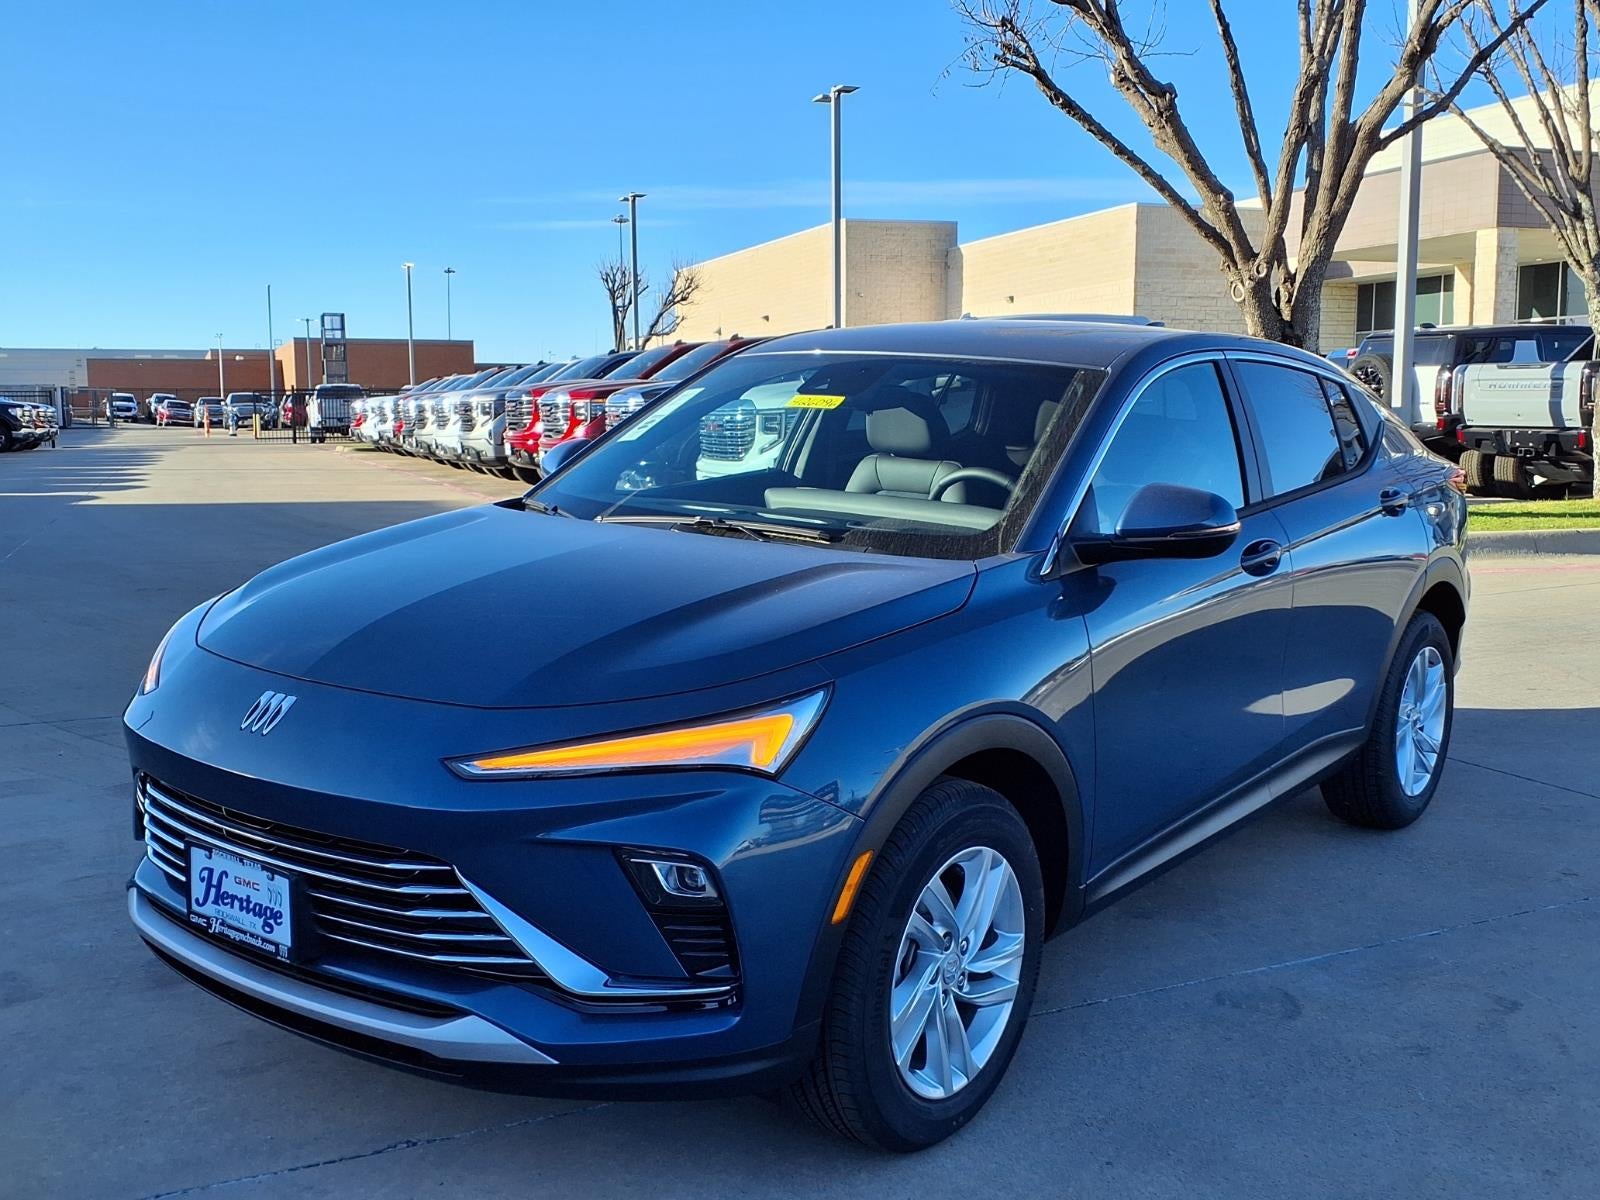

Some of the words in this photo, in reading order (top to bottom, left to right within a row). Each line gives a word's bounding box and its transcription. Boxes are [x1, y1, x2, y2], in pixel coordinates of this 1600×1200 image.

[234, 876, 260, 891] GMC
[194, 866, 284, 934] Heritage
[190, 914, 208, 927] GMC
